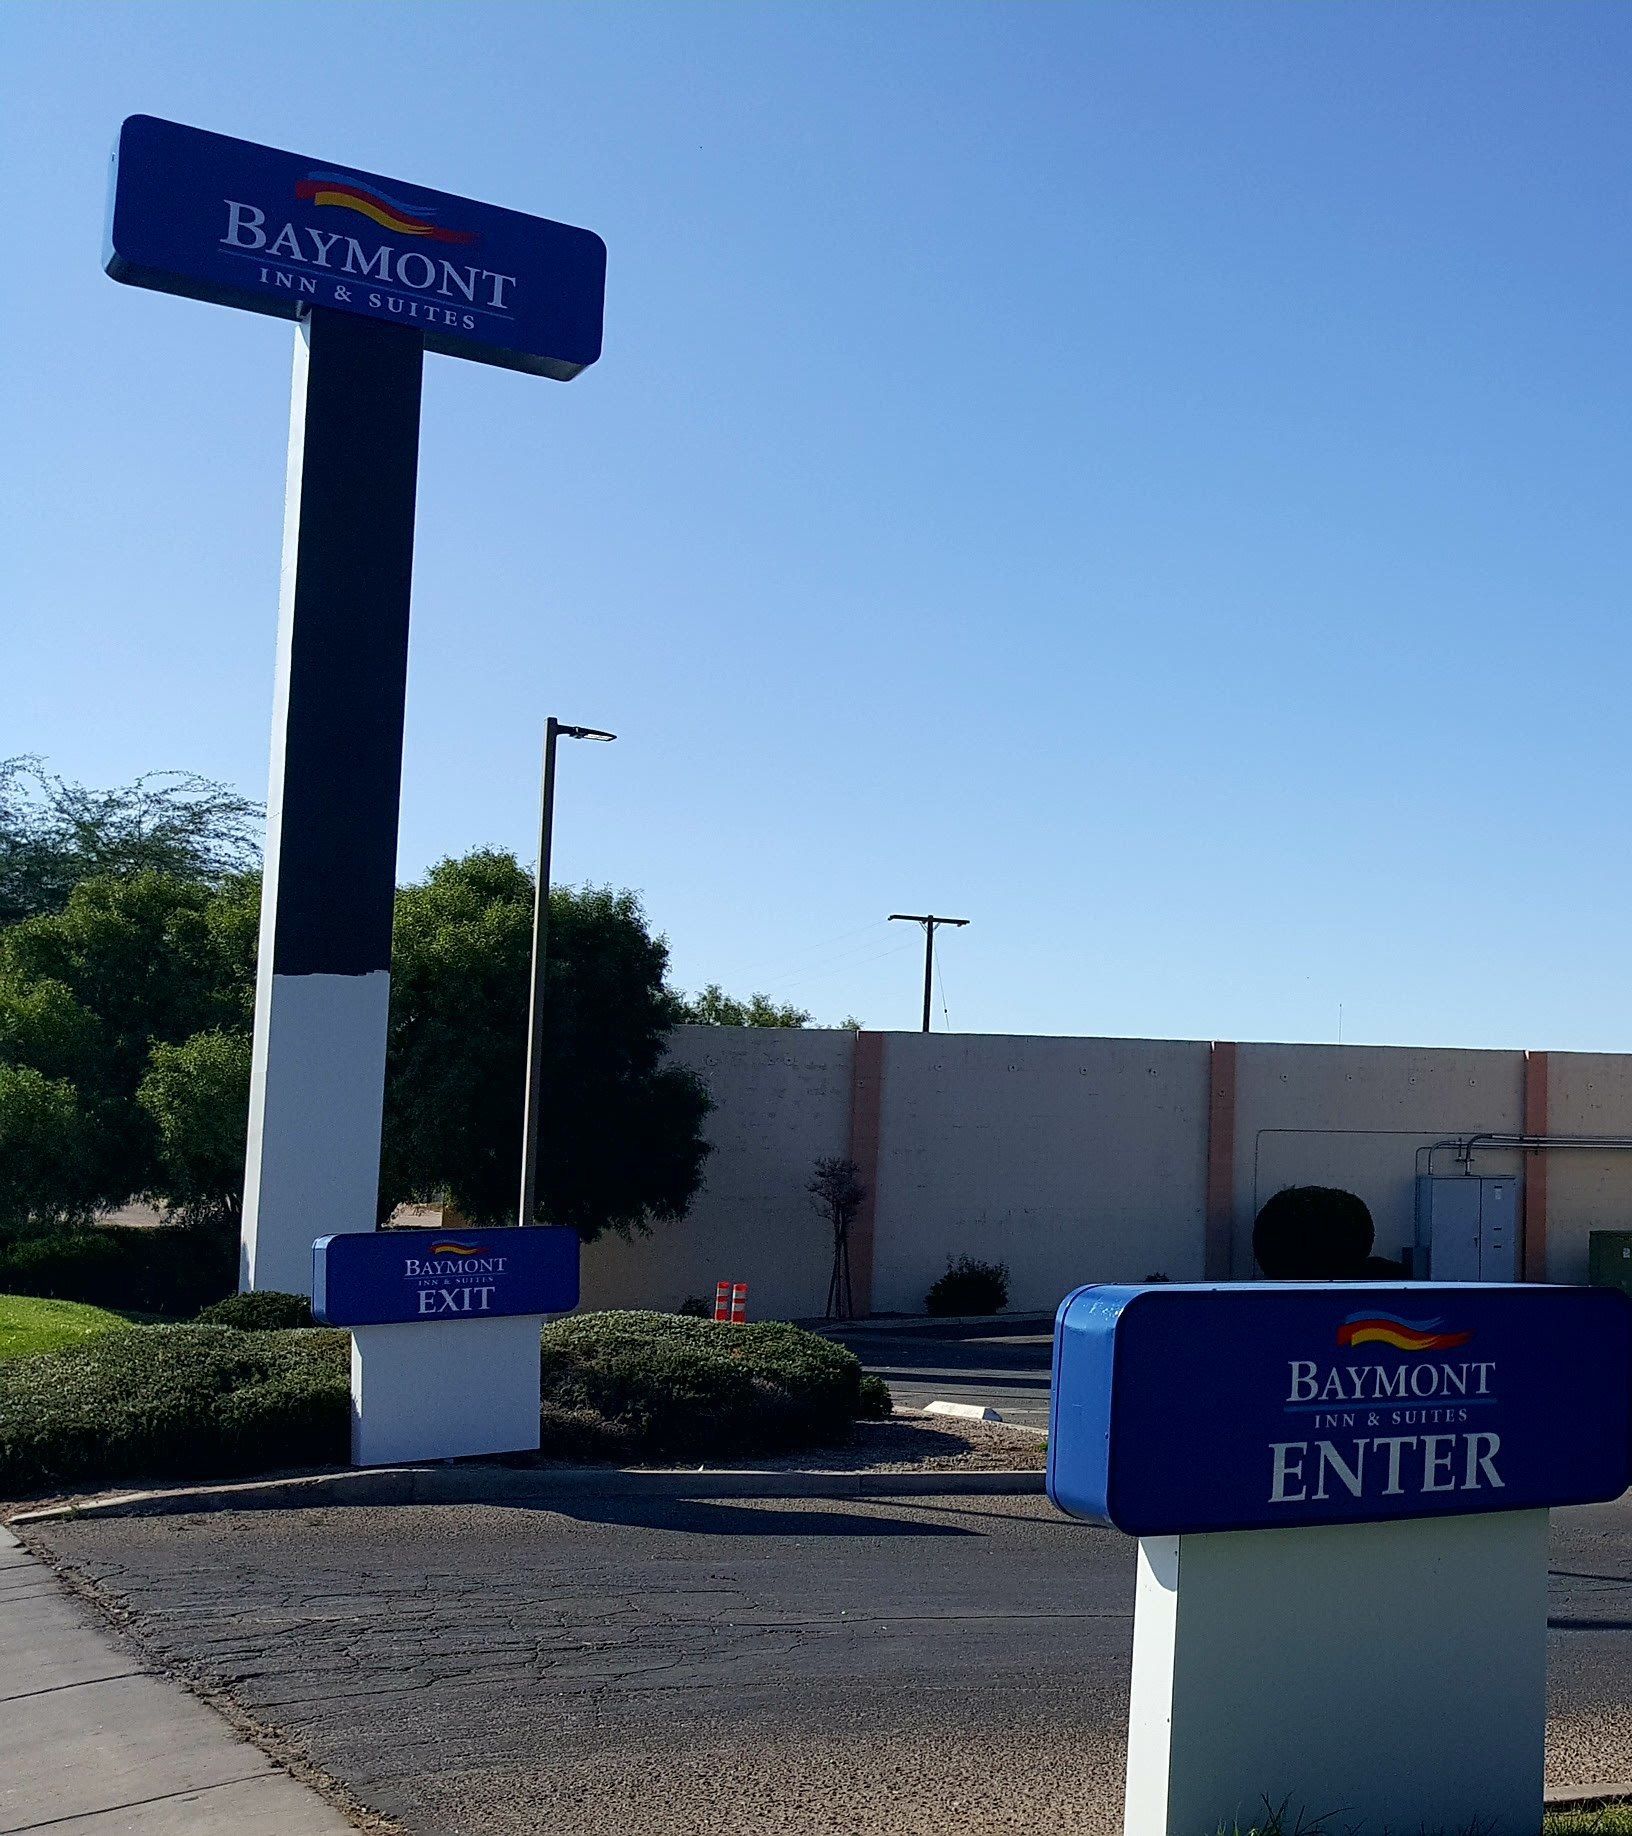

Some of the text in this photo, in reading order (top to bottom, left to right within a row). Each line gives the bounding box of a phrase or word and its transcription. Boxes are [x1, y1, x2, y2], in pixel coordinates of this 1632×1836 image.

[219, 199, 517, 310] BAYMONT
[259, 267, 476, 330] INN & SUITES
[404, 1257, 507, 1276] BAYMONT
[417, 1286, 496, 1314] EXIT
[1285, 1360, 1496, 1402] BAYMONT
[1314, 1408, 1468, 1429] INN & SUITES
[1267, 1431, 1506, 1504] ENTER
